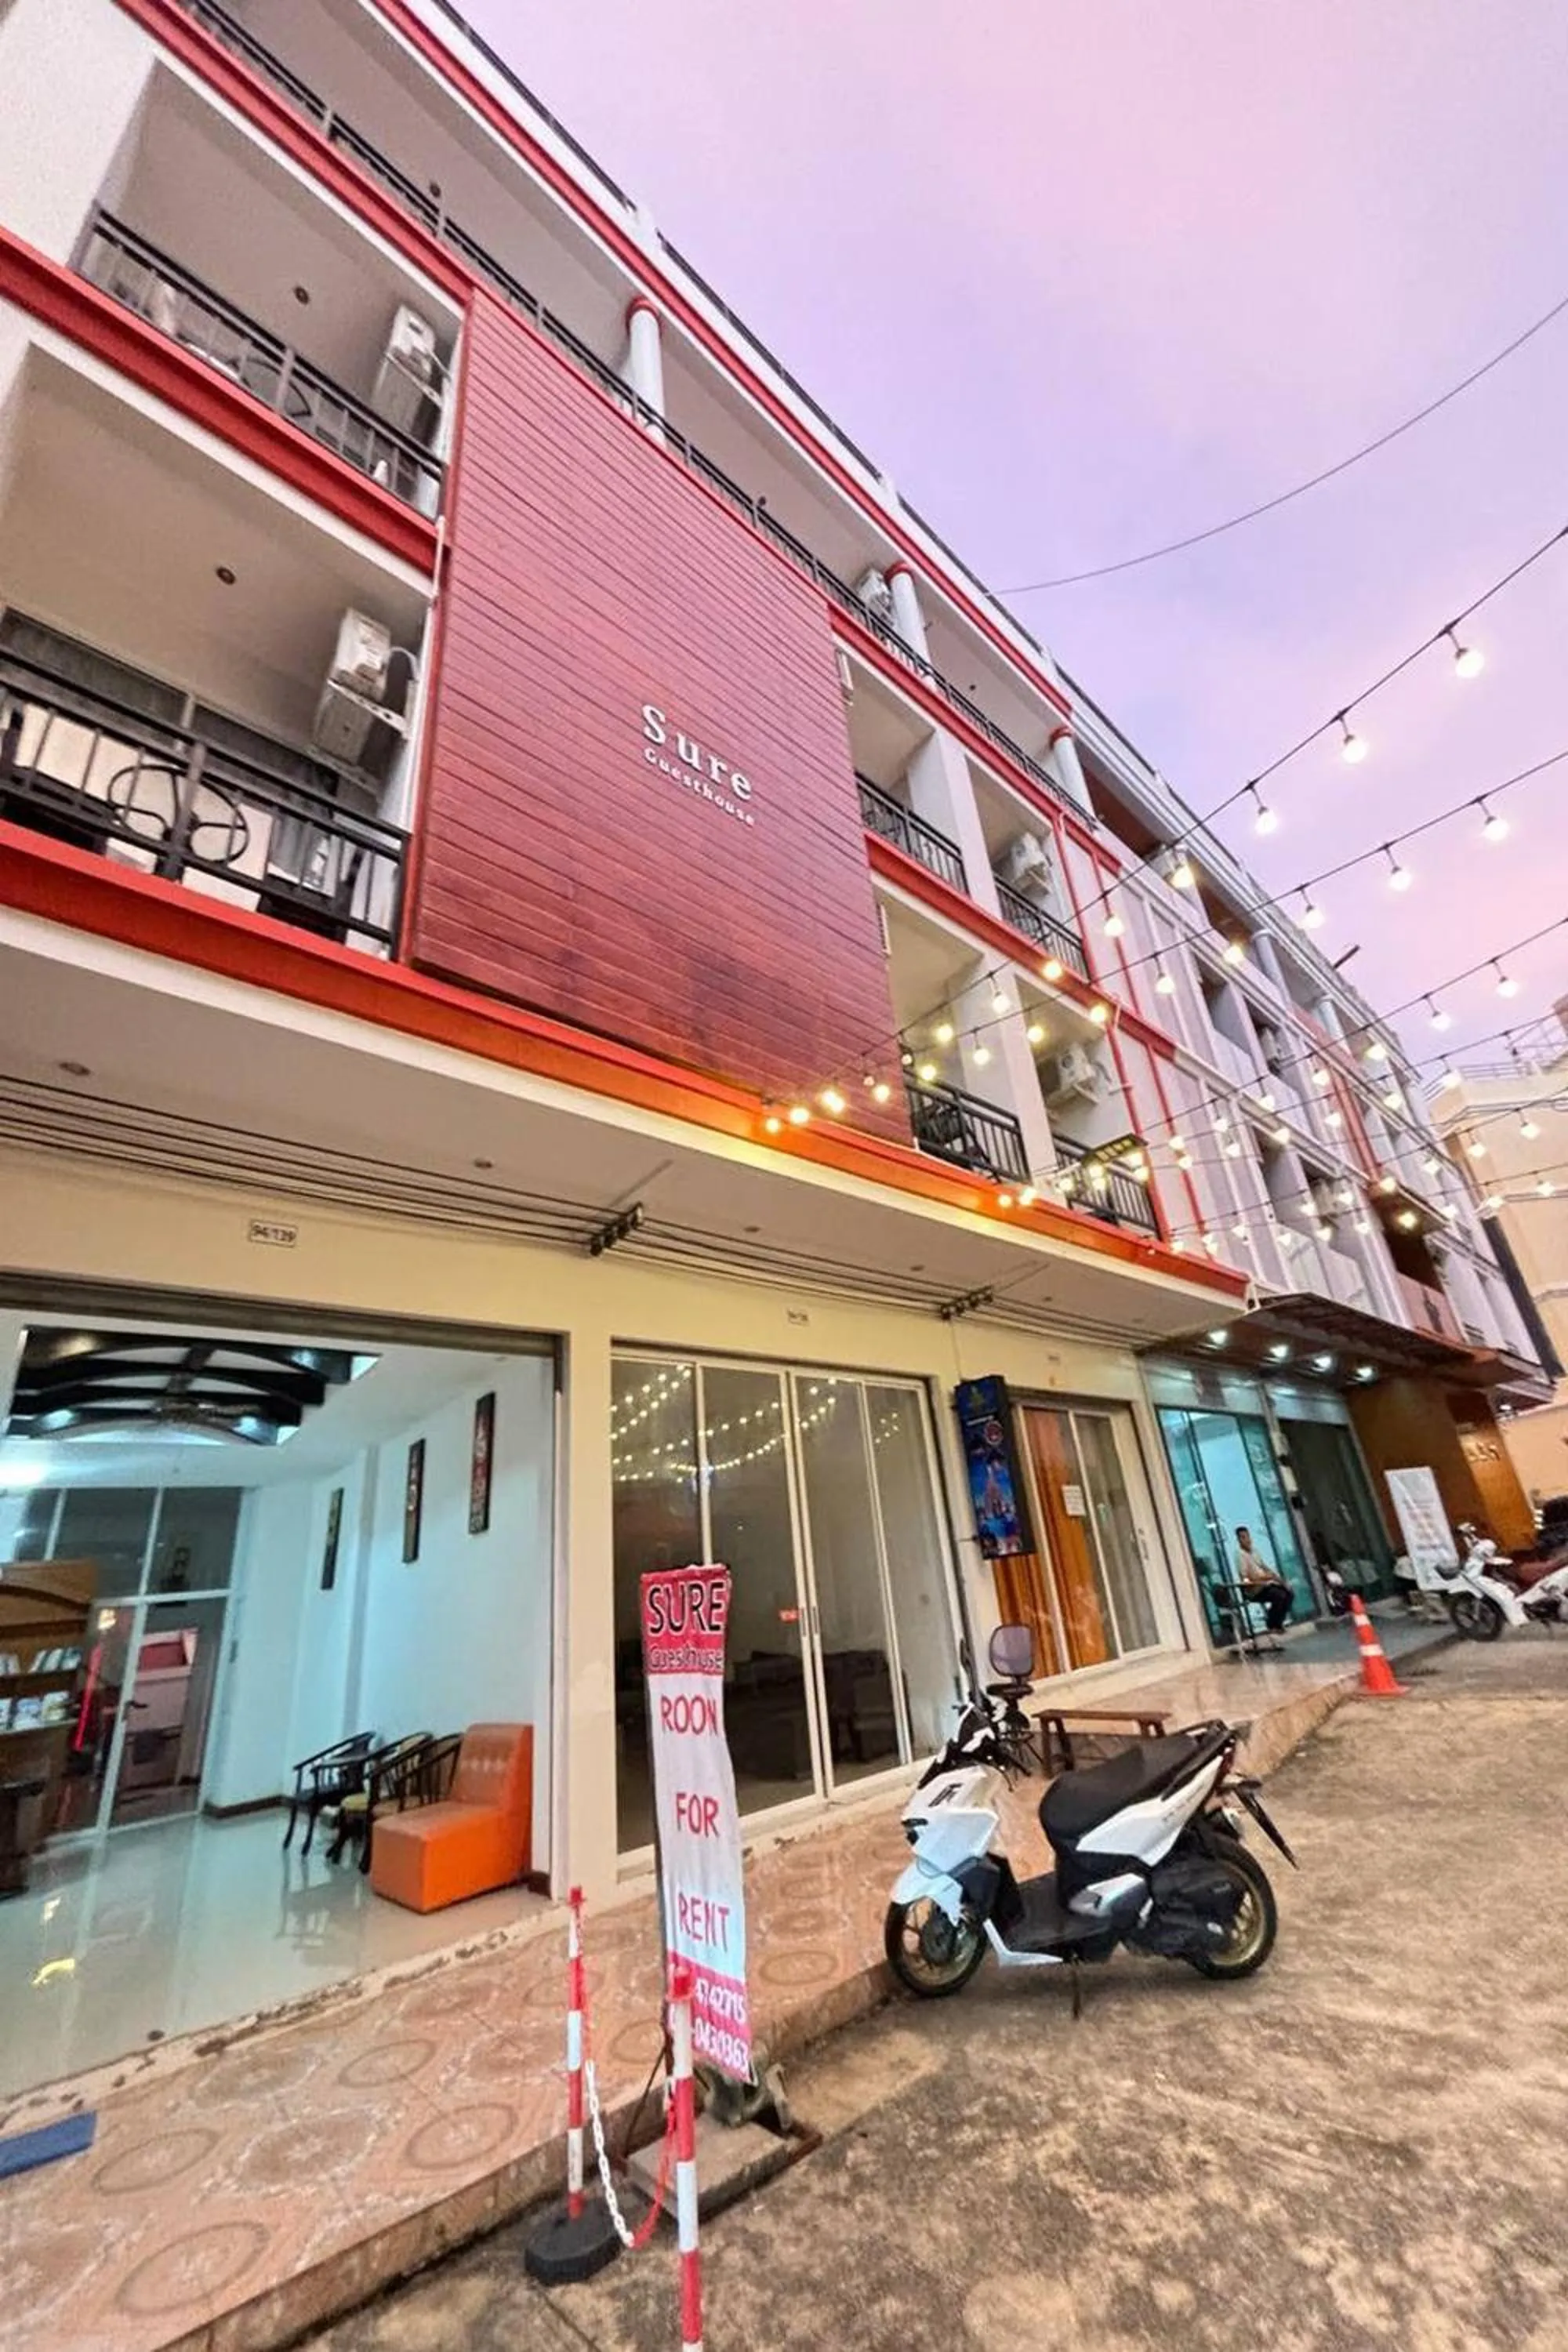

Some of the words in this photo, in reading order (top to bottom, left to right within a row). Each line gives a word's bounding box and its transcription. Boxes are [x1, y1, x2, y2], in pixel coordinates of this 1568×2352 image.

[642, 705, 752, 801] Sure
[648, 1581, 726, 1635] SURE
[650, 1643, 724, 1670] Guesthuse
[676, 1792, 720, 1838] FOR
[677, 1891, 731, 1953] RENT
